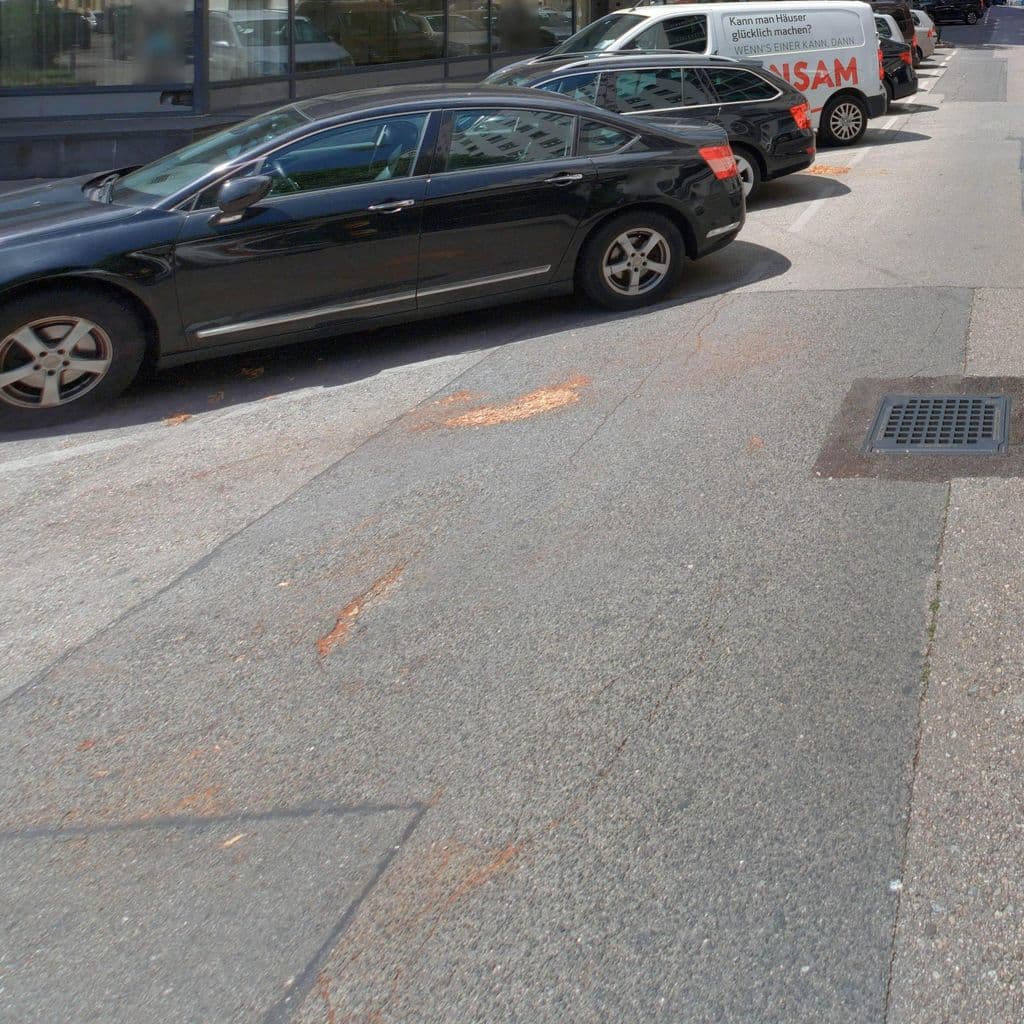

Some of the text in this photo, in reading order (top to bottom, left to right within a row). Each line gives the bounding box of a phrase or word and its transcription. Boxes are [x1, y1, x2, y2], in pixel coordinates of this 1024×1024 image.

[729, 14, 807, 26] Kann man Häuser
[731, 24, 812, 42] glücklich machen?
[775, 41, 801, 52] EINER
